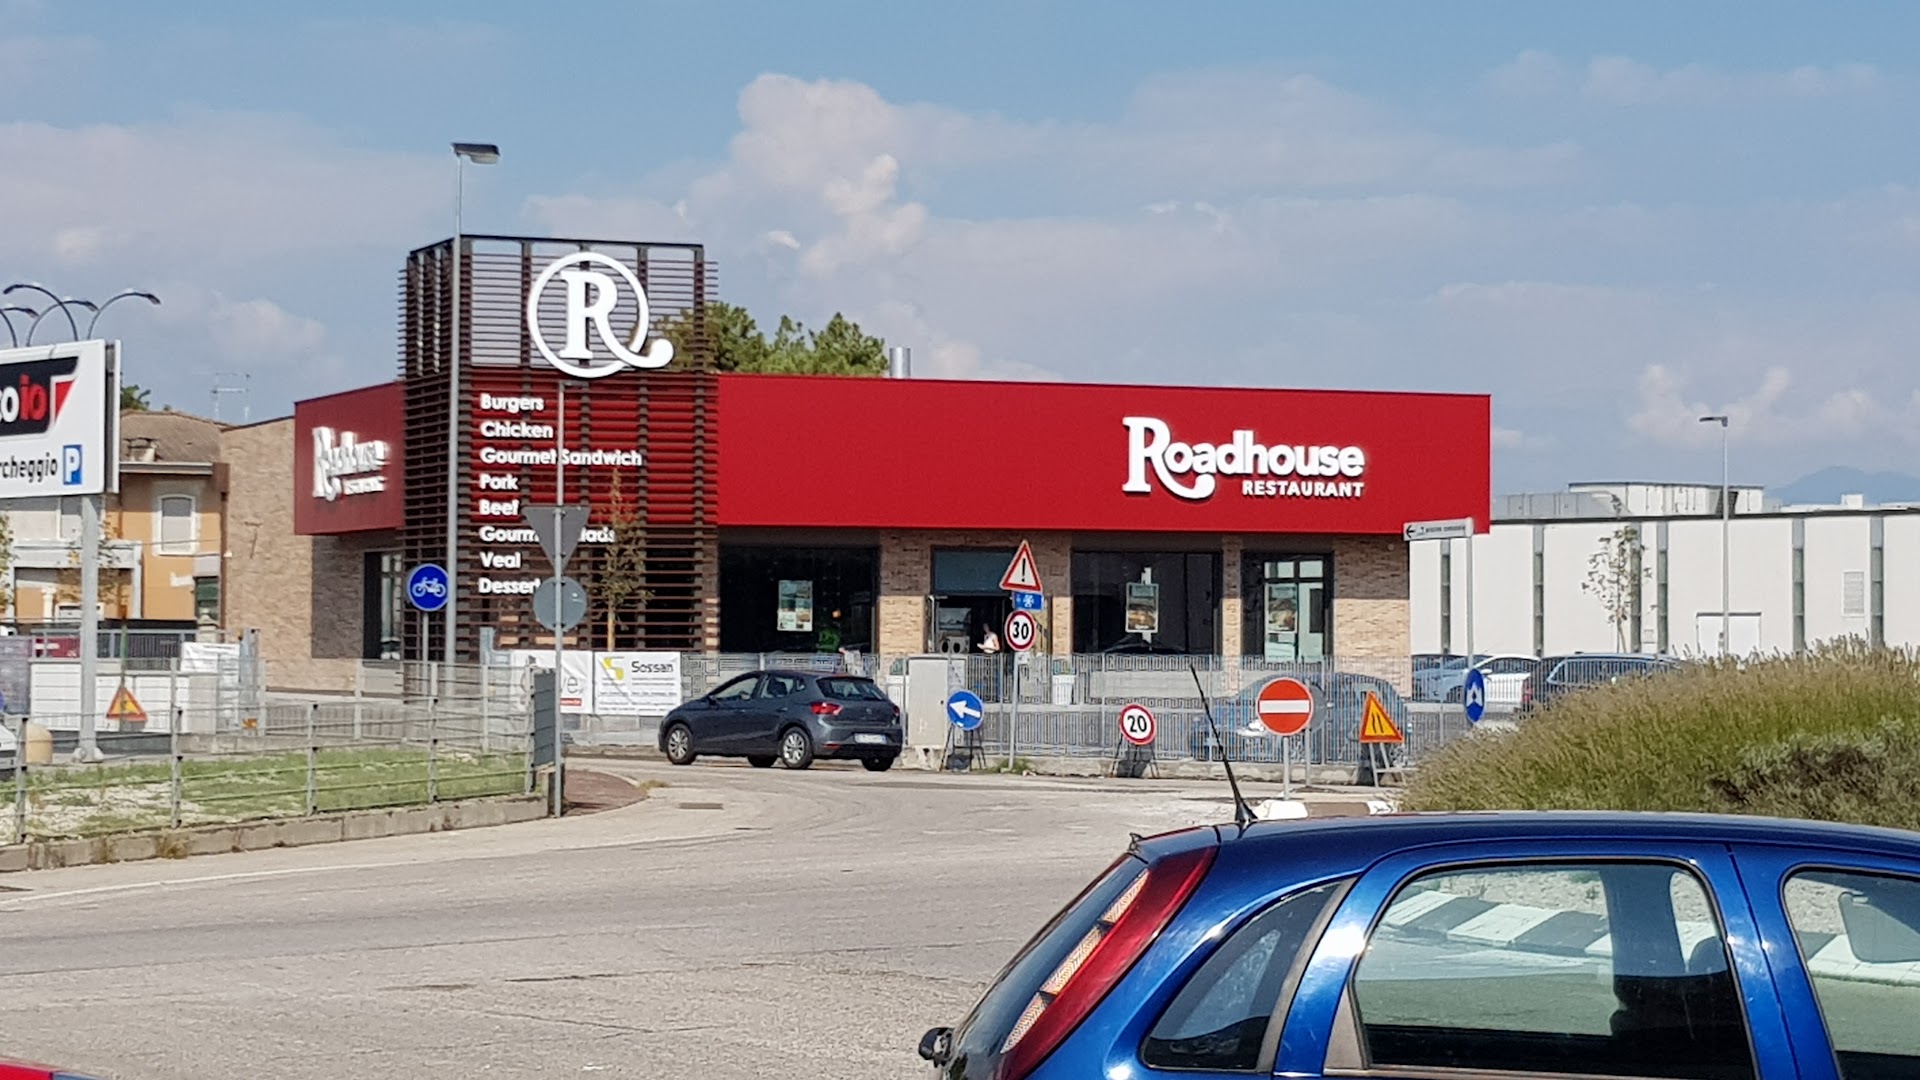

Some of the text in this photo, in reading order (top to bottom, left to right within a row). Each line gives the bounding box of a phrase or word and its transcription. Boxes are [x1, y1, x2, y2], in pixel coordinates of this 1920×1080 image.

[0, 374, 48, 423] oio
[480, 392, 544, 413] Burgers
[480, 420, 554, 438] Chicken
[64, 447, 81, 483] P
[480, 446, 643, 467] Gourmet Sandwich
[1122, 416, 1365, 499] Roadhouse
[480, 473, 519, 490] Pork
[1242, 480, 1364, 497] RESTAURANT
[479, 498, 519, 516] Beef
[480, 525, 616, 543] Gourm lads
[480, 551, 521, 568] Veal
[1012, 621, 1029, 641] 30
[1127, 715, 1147, 733] 20
